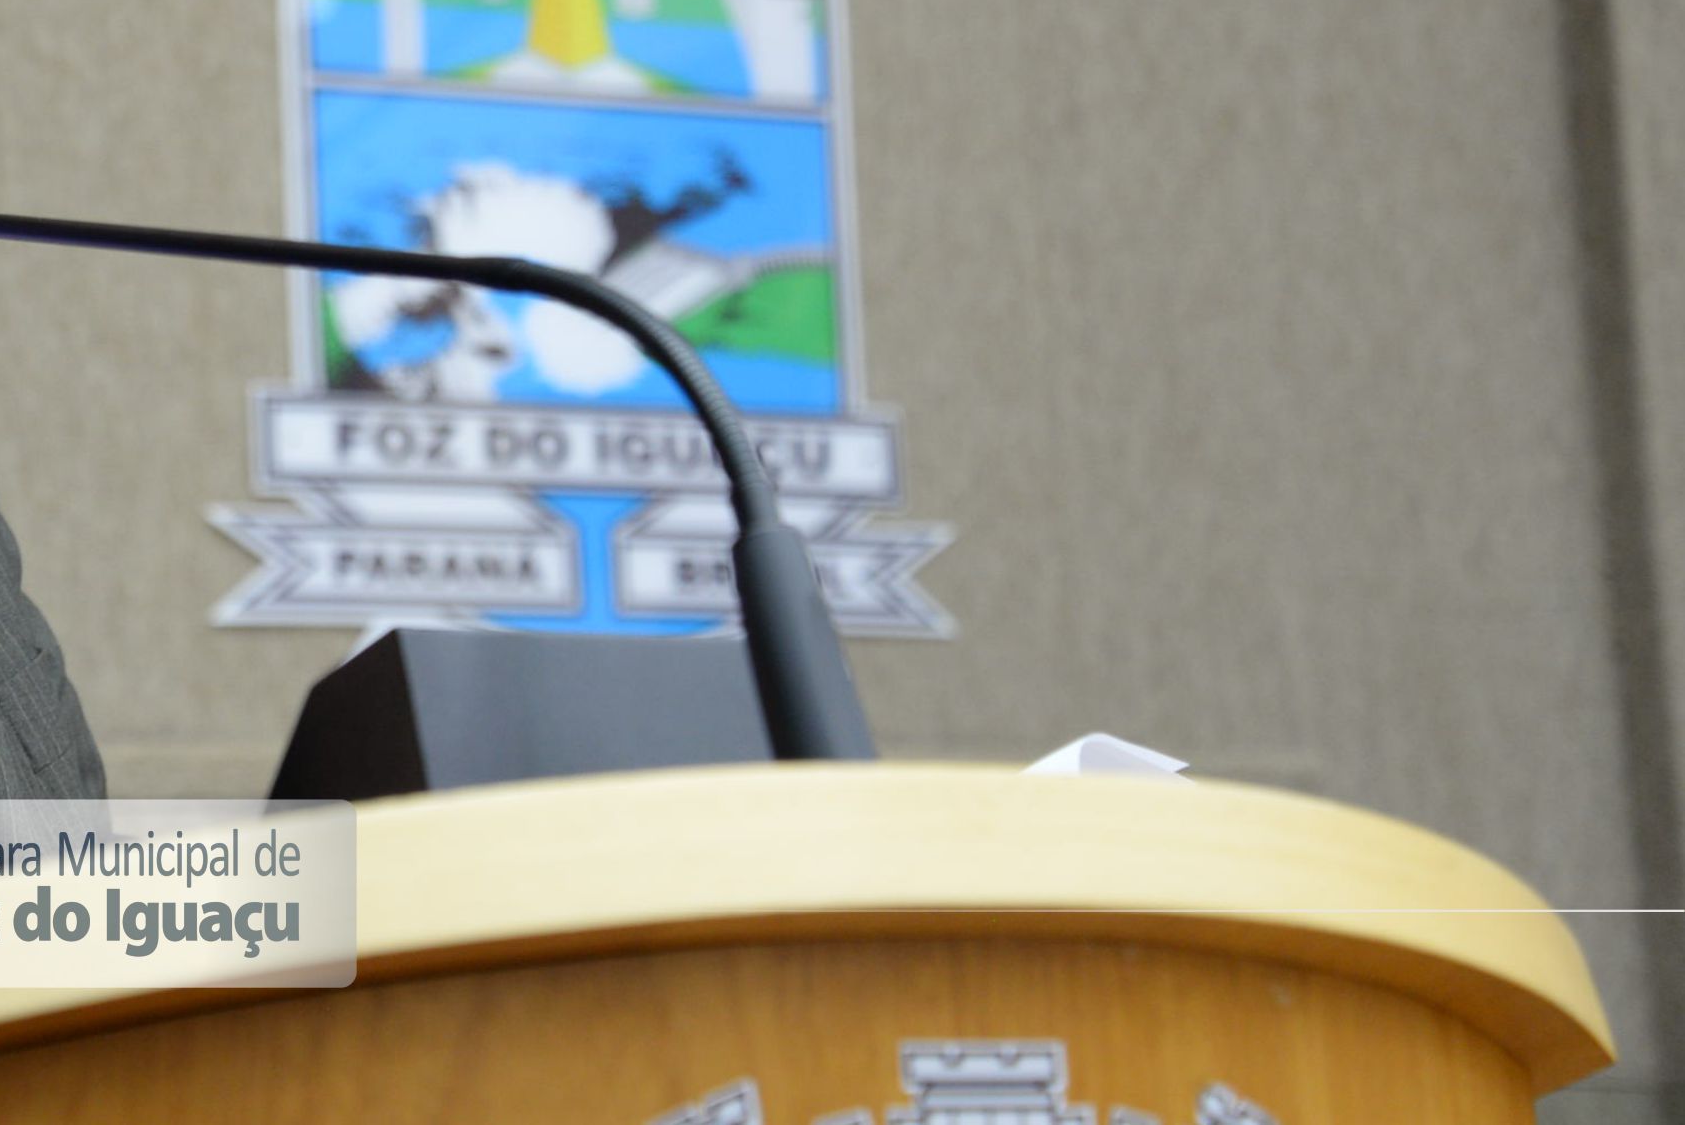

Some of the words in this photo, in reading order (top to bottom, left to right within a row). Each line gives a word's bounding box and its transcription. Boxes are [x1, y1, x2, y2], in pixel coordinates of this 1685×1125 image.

[336, 421, 455, 467] FOZ
[487, 427, 569, 473] DO
[594, 432, 832, 485] IGUÇU
